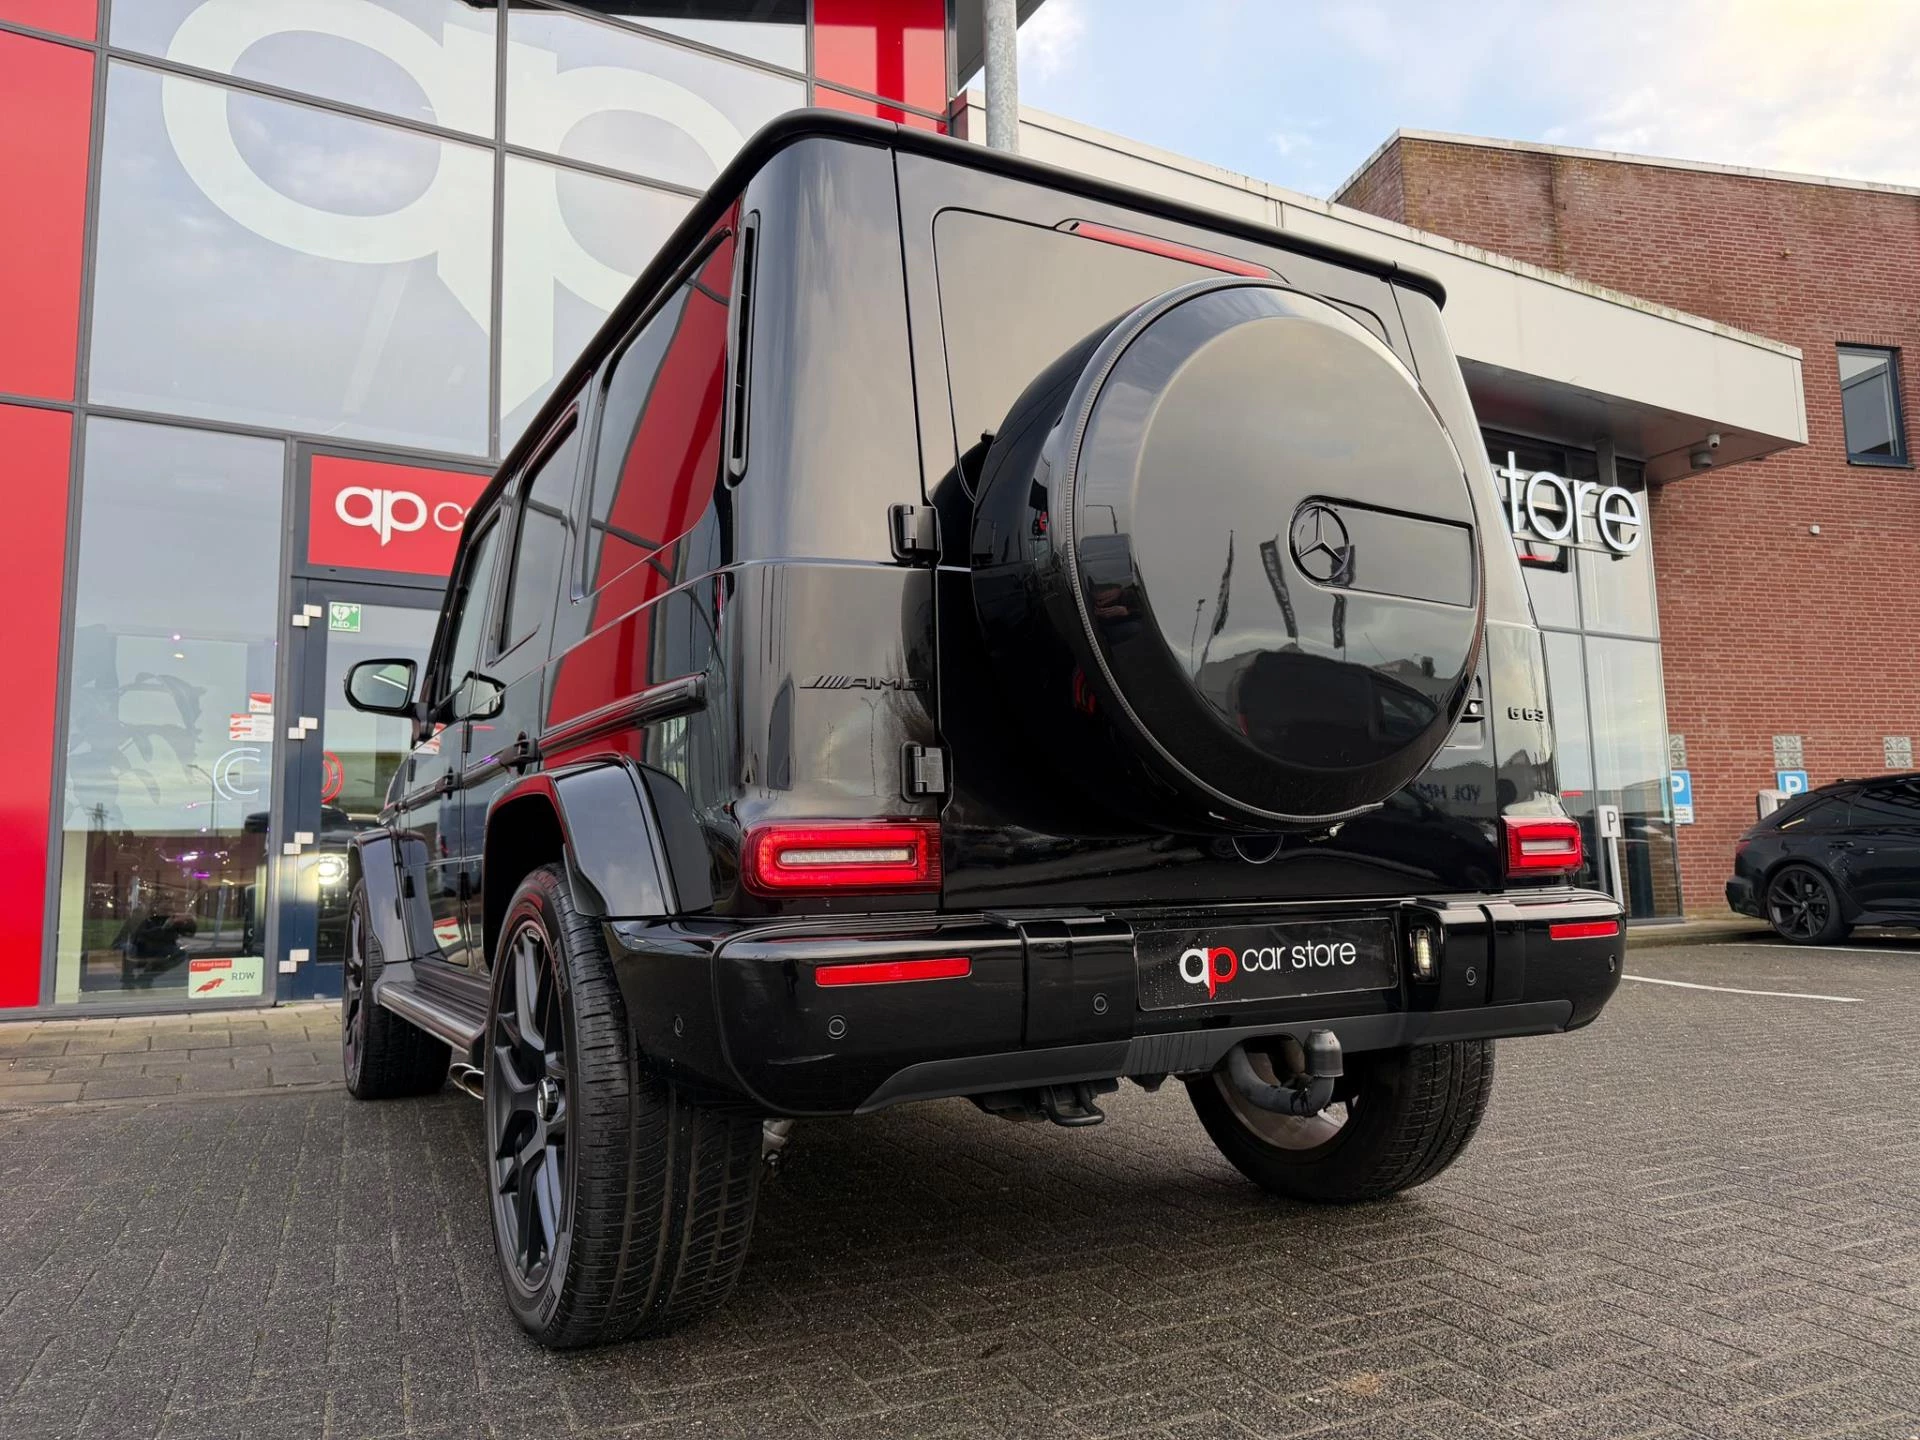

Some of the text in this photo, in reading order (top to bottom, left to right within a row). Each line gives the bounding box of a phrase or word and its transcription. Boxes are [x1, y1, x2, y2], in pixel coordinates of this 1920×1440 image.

[1500, 451, 1642, 552] tore
[335, 486, 472, 546] ap c
[332, 620, 350, 629] AED
[1671, 775, 1685, 793] P
[1784, 775, 1802, 795] P
[1606, 810, 1617, 832] P
[231, 971, 255, 981] RDW
[1179, 940, 1357, 1000] ap car store
